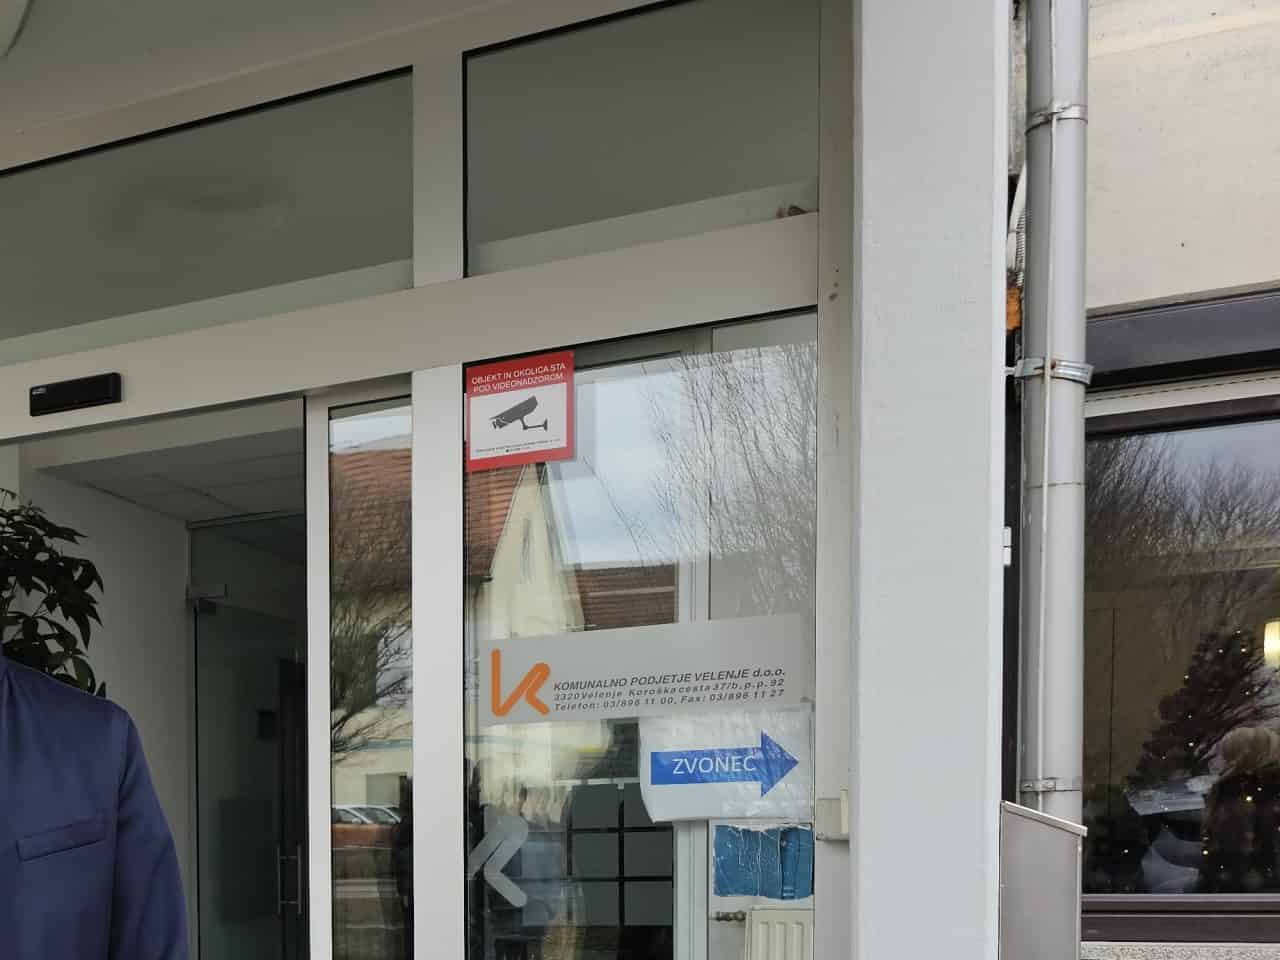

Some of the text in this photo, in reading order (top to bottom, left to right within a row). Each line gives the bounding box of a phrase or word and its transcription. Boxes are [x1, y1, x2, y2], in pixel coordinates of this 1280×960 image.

[471, 362, 566, 385] OBJEKT IN OKOLICA STA
[473, 383, 492, 393] POD
[553, 667, 786, 691] KOMUNALNO PODJETJE VELENJE d.o.o.
[672, 754, 757, 775] ZVONEC
